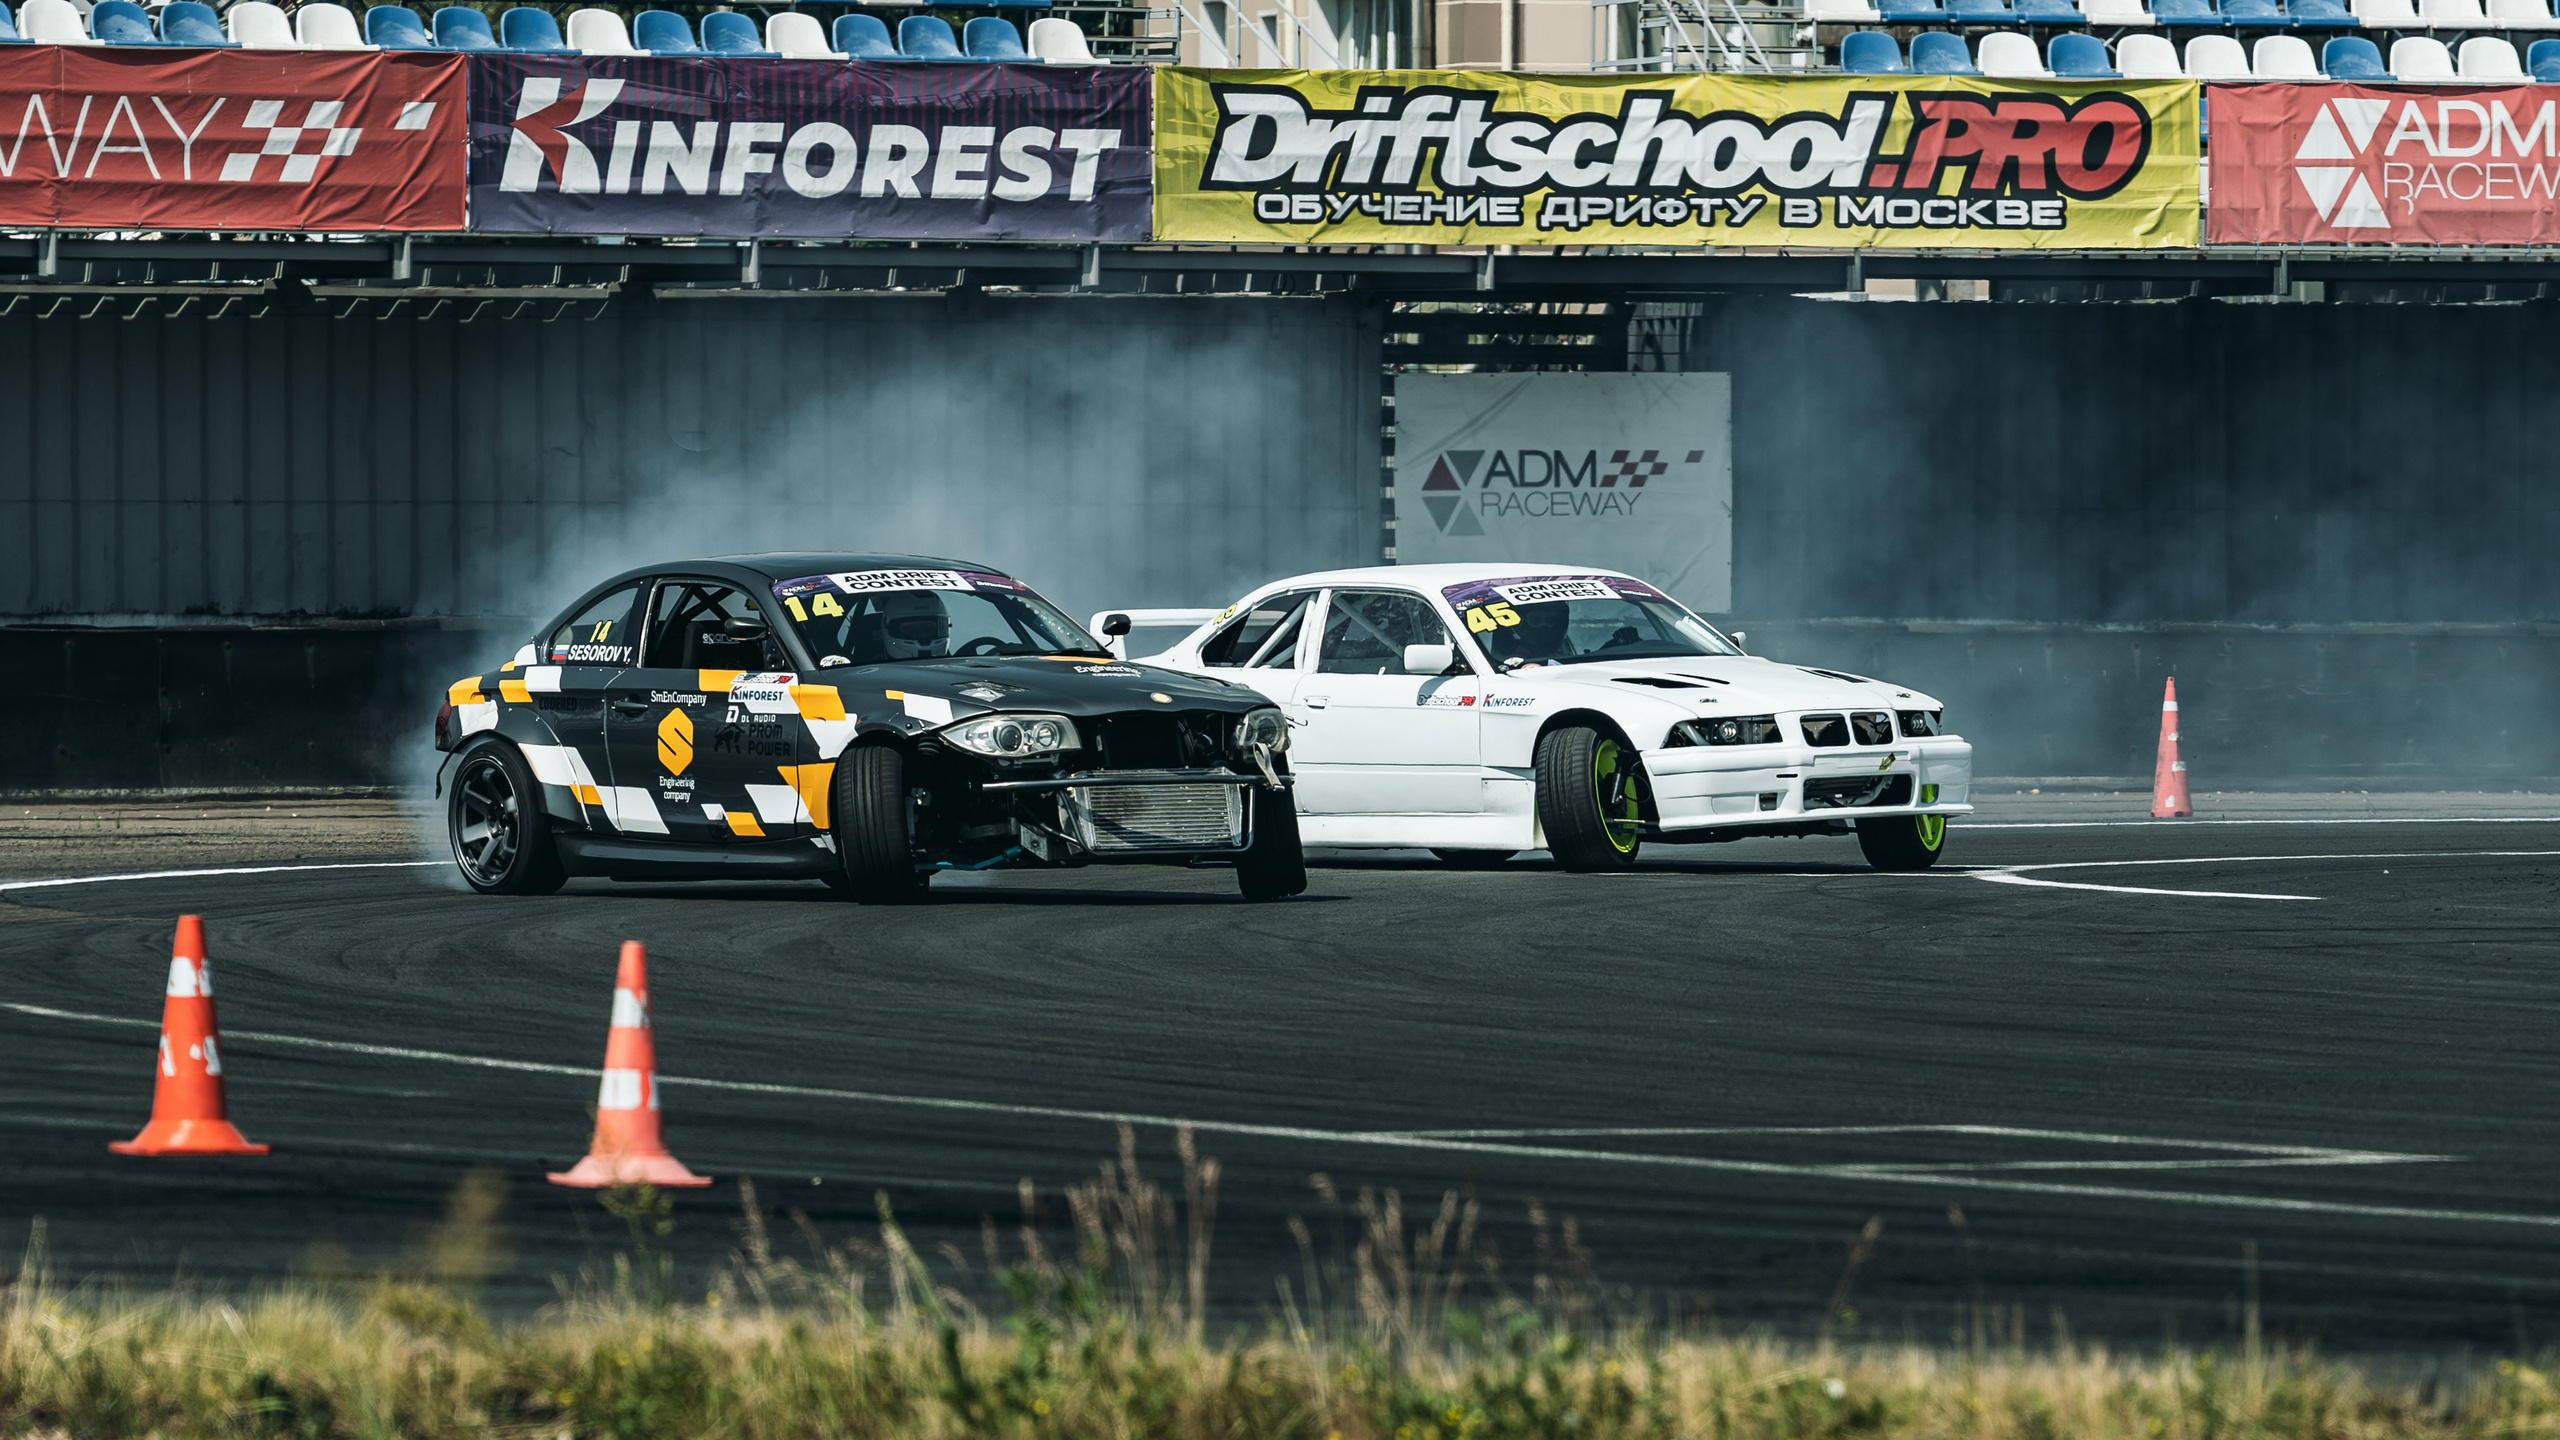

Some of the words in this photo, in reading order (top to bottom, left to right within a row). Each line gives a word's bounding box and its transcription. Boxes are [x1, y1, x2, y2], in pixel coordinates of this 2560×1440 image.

[0, 93, 226, 180] WAY
[2384, 100, 2557, 157] ADM
[500, 77, 1121, 202] KINFOREST
[1258, 194, 1520, 222] ОБУЧЕНИЕ
[1541, 196, 1761, 228] ДРИФТУ
[1784, 198, 1818, 224] В
[1839, 196, 2064, 226] МОСКВЕ
[1481, 450, 1597, 488] ADM
[1480, 492, 1642, 516] RACEWAY
[844, 573, 891, 582] ADM
[894, 572, 950, 580] DRIFT
[849, 579, 958, 590] CONTEST
[1508, 584, 1547, 595] ADM
[1550, 582, 1598, 591] DRIFT
[1514, 589, 1606, 602] CONTEST
[784, 592, 845, 622] 14
[1466, 601, 1522, 634] 45
[589, 620, 613, 643] 14
[567, 644, 623, 662] SESOROV
[650, 690, 707, 706] SmEnCompany
[730, 685, 784, 701] KINFOREST
[1482, 693, 1536, 707] KINFOREST
[754, 714, 776, 722] AUDIO
[748, 723, 783, 739] PROM
[748, 740, 791, 757] POWER
[659, 776, 695, 790] Engineering
[663, 791, 691, 803] company
